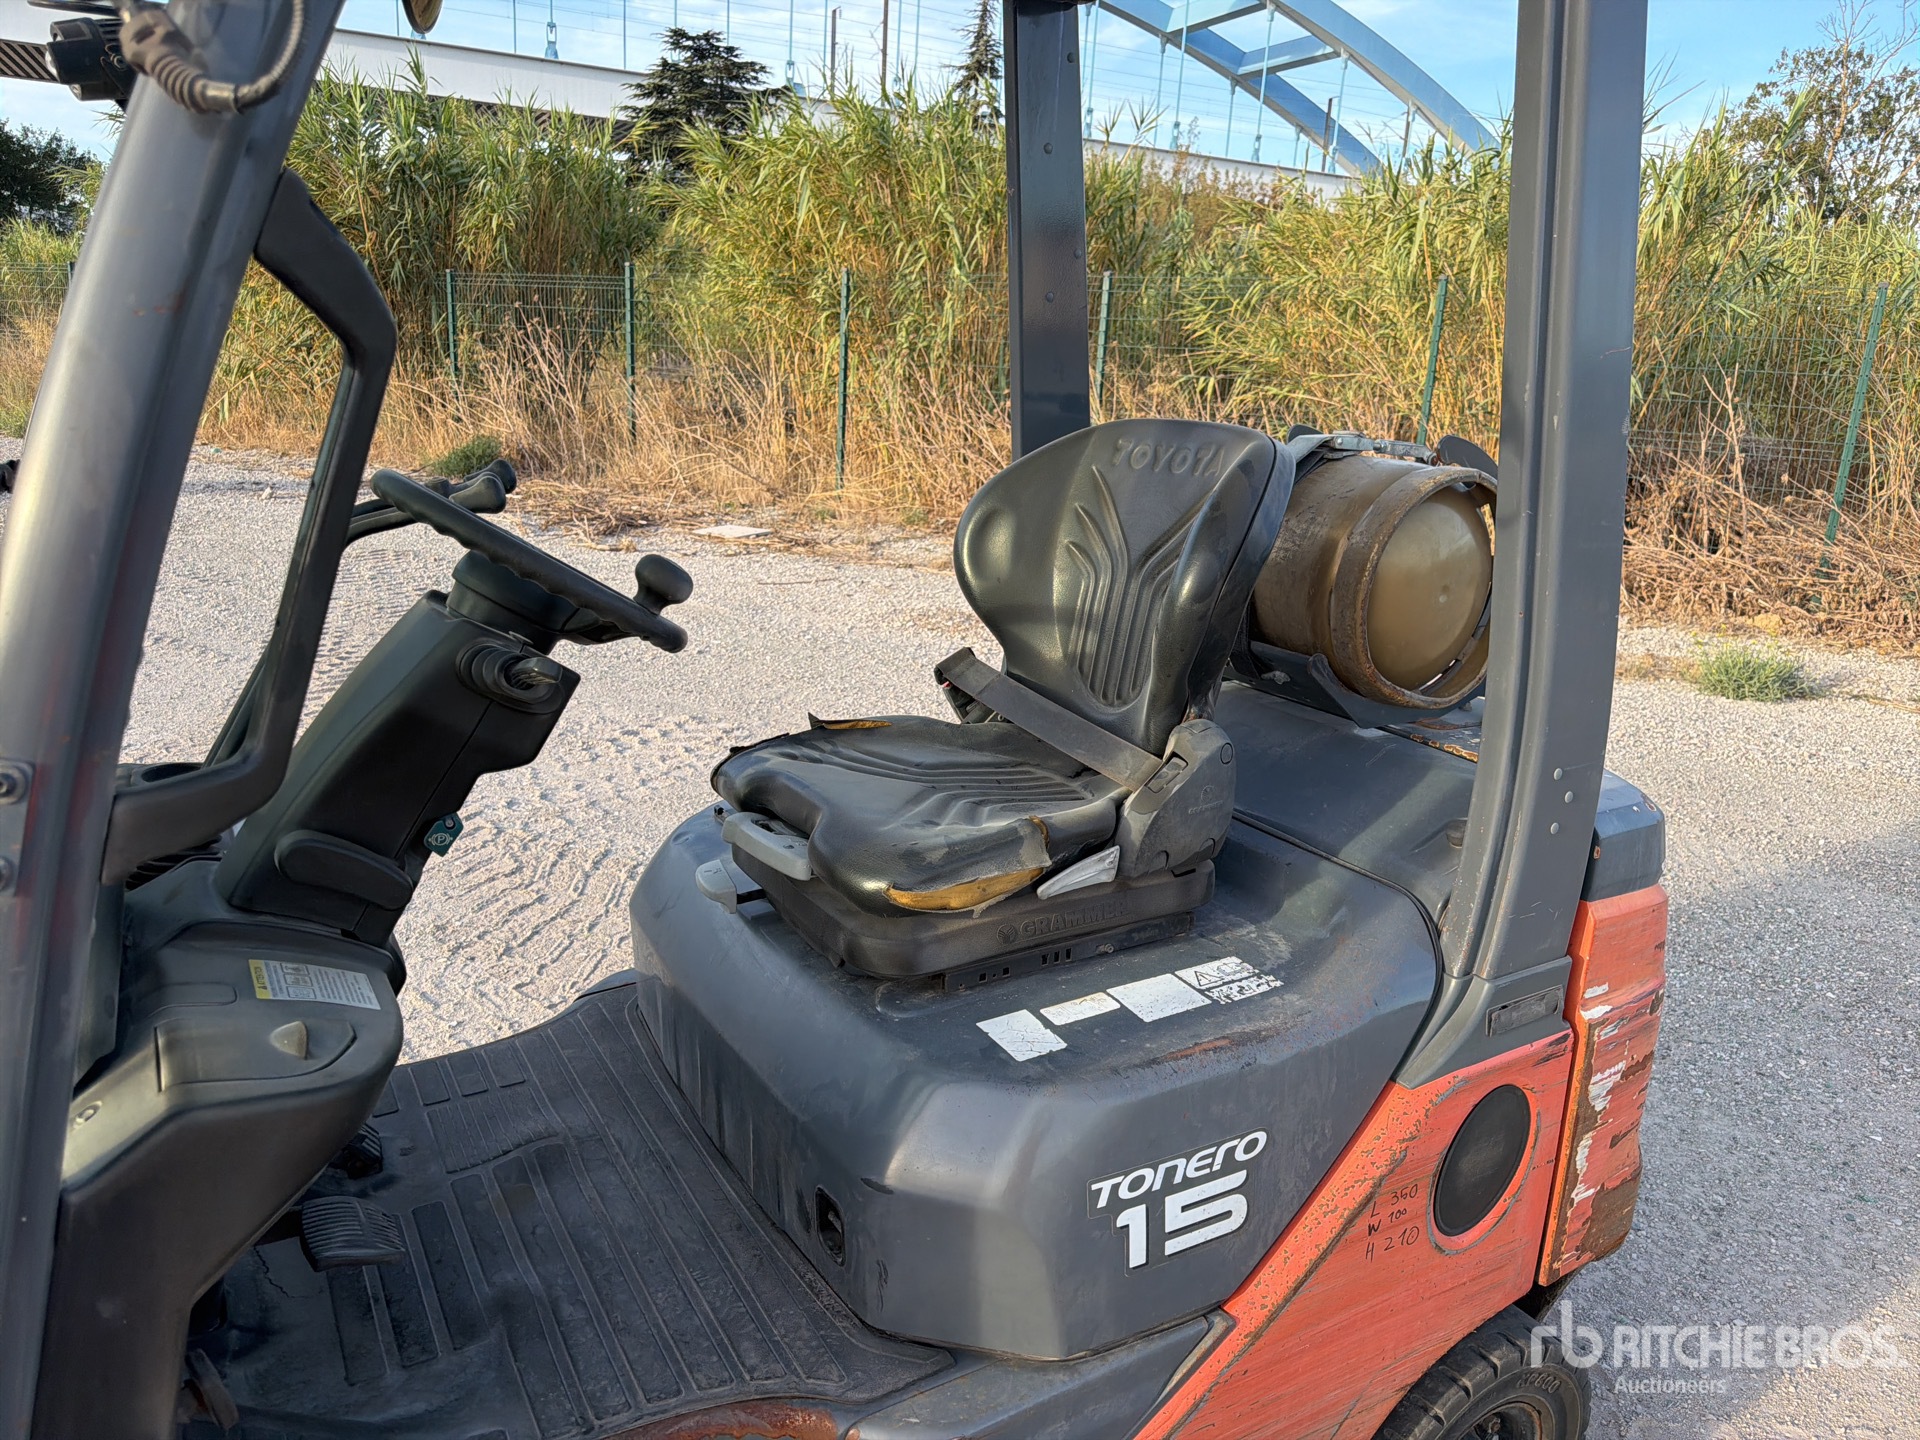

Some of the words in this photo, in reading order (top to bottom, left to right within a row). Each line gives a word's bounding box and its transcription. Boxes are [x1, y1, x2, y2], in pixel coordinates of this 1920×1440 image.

[1112, 438, 1225, 477] TOYOTA
[1390, 1183, 1418, 1206] 350
[1116, 1169, 1248, 1269] 15
[1367, 1218, 1382, 1237] W
[1383, 1225, 1420, 1252] 210
